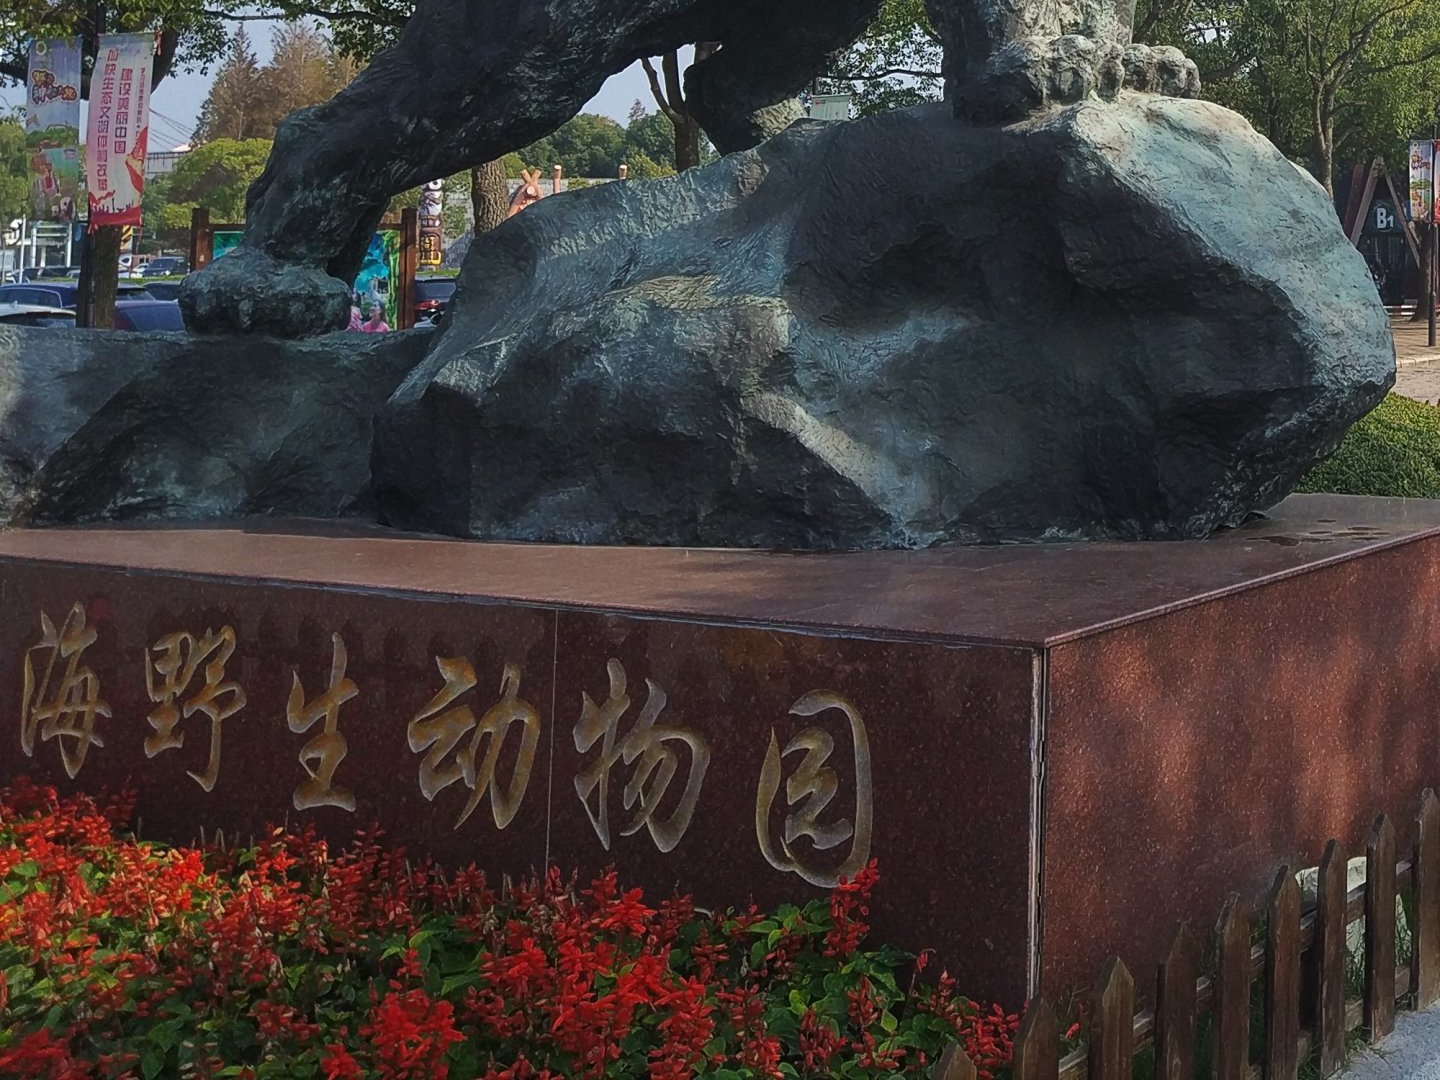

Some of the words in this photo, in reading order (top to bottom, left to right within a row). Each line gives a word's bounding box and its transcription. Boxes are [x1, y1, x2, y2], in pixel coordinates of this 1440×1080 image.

[114, 67, 133, 154] 建设美丽中国
[1376, 207, 1394, 229] B1
[19, 600, 880, 889] 海野生动物园
